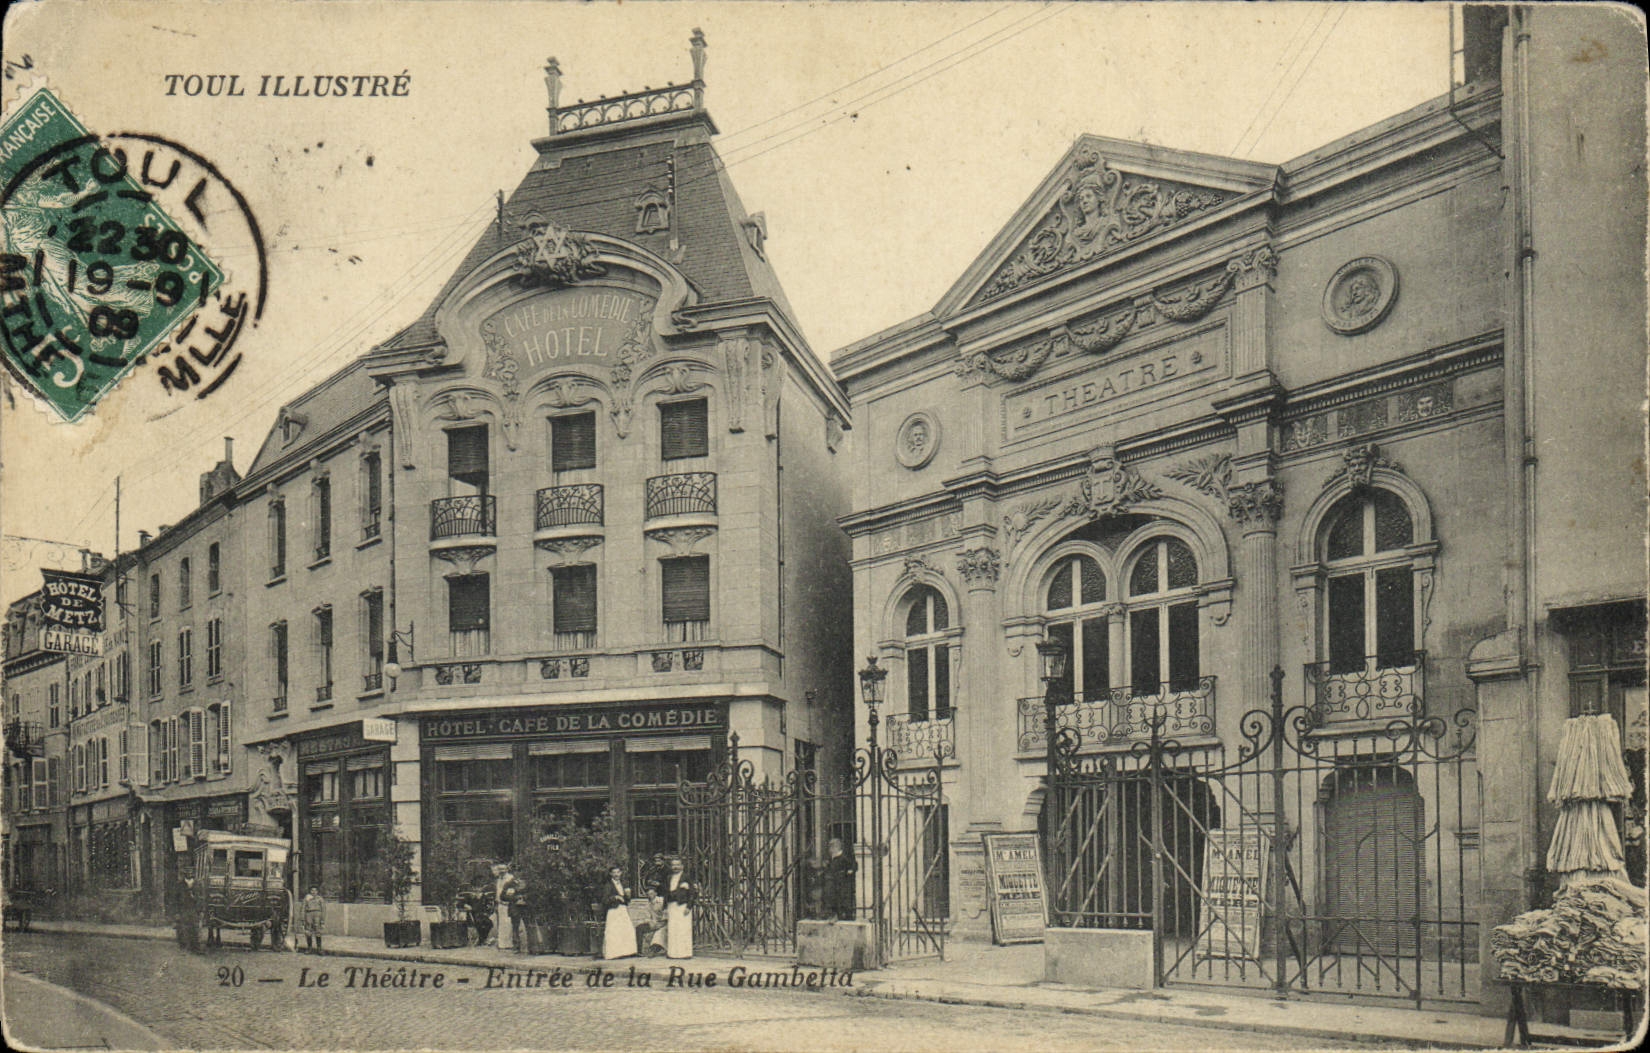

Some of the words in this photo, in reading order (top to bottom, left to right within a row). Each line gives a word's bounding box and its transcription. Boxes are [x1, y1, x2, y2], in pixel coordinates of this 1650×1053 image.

[42, 147, 206, 229] TOUL
[523, 326, 608, 366] HOTEL
[1044, 355, 1178, 415] THEATRE
[46, 579, 97, 602] HÔTEL
[60, 597, 84, 607] DE
[46, 604, 98, 625] METZ
[44, 631, 99, 655] GARAGE
[366, 722, 395, 737] GARAGE
[499, 716, 549, 733] CAFÉ
[555, 716, 581, 731] DE
[587, 714, 611, 729] LA
[618, 709, 718, 728] COMÉDIE
